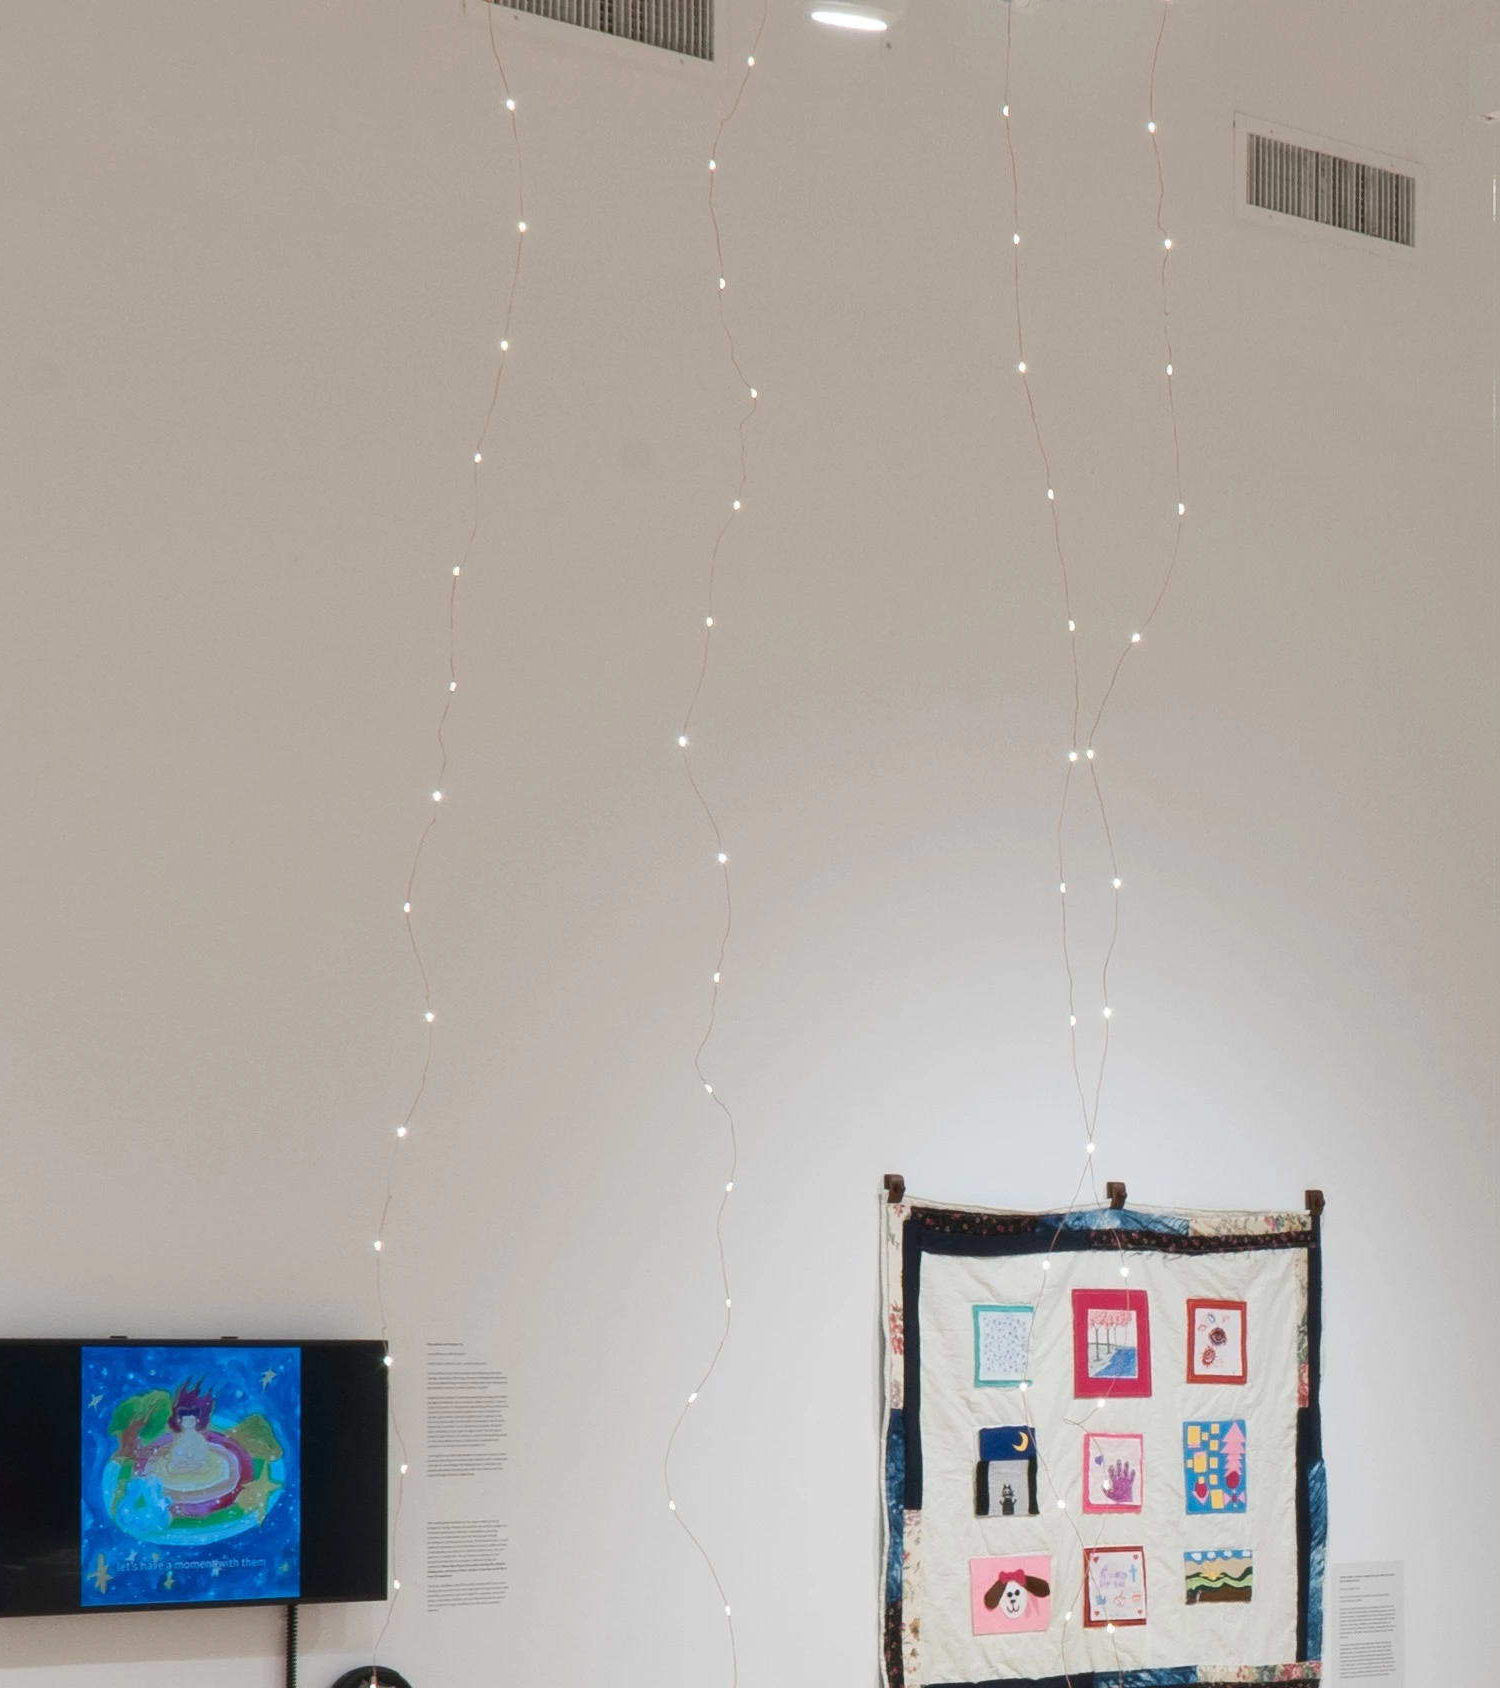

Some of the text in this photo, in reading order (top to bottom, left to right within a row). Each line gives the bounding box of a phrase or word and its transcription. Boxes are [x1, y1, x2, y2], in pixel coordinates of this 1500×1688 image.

[140, 1560, 164, 1571] have
[219, 1558, 240, 1569] with
[241, 1557, 267, 1569] them
